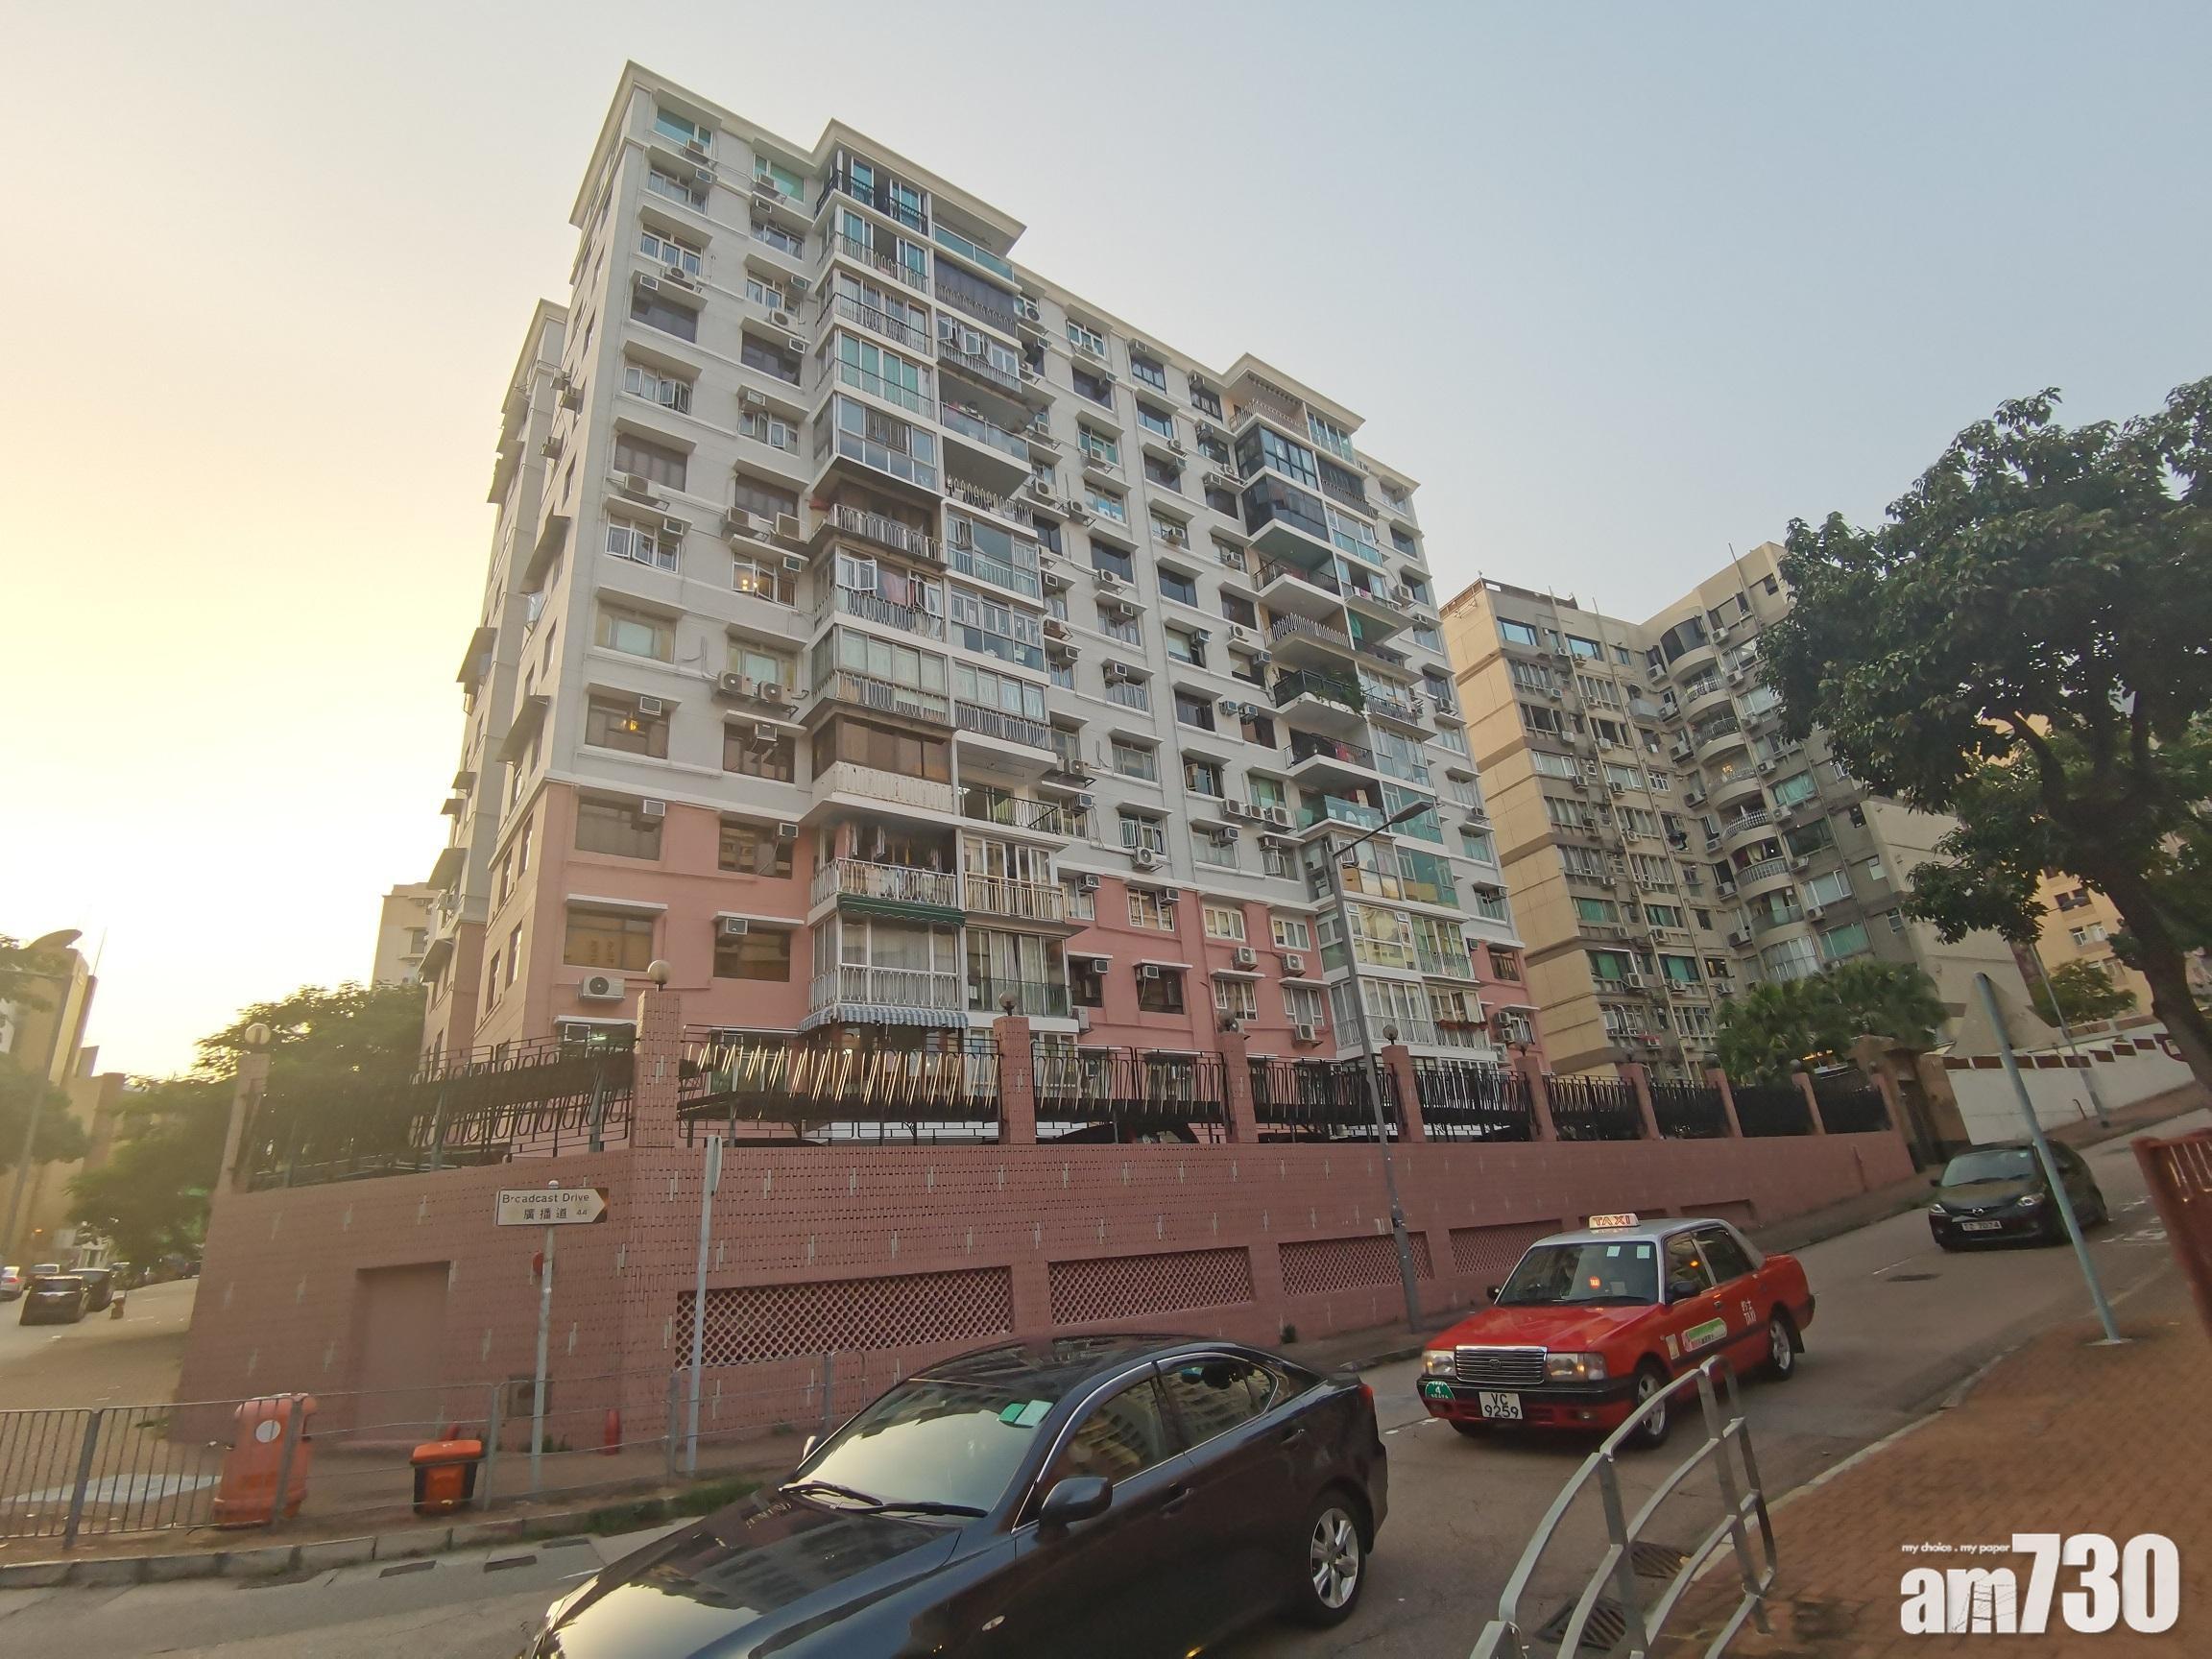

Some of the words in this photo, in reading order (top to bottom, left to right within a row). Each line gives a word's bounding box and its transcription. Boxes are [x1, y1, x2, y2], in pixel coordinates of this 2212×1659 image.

[502, 1193, 558, 1204] Broadcast
[563, 1192, 589, 1203] Drive
[523, 1208, 566, 1219] 廣播道
[1593, 1214, 1631, 1226] TAXI
[1434, 1385, 1442, 1395] 4
[1491, 1393, 1507, 1406] VC
[1484, 1405, 1519, 1418] 9259
